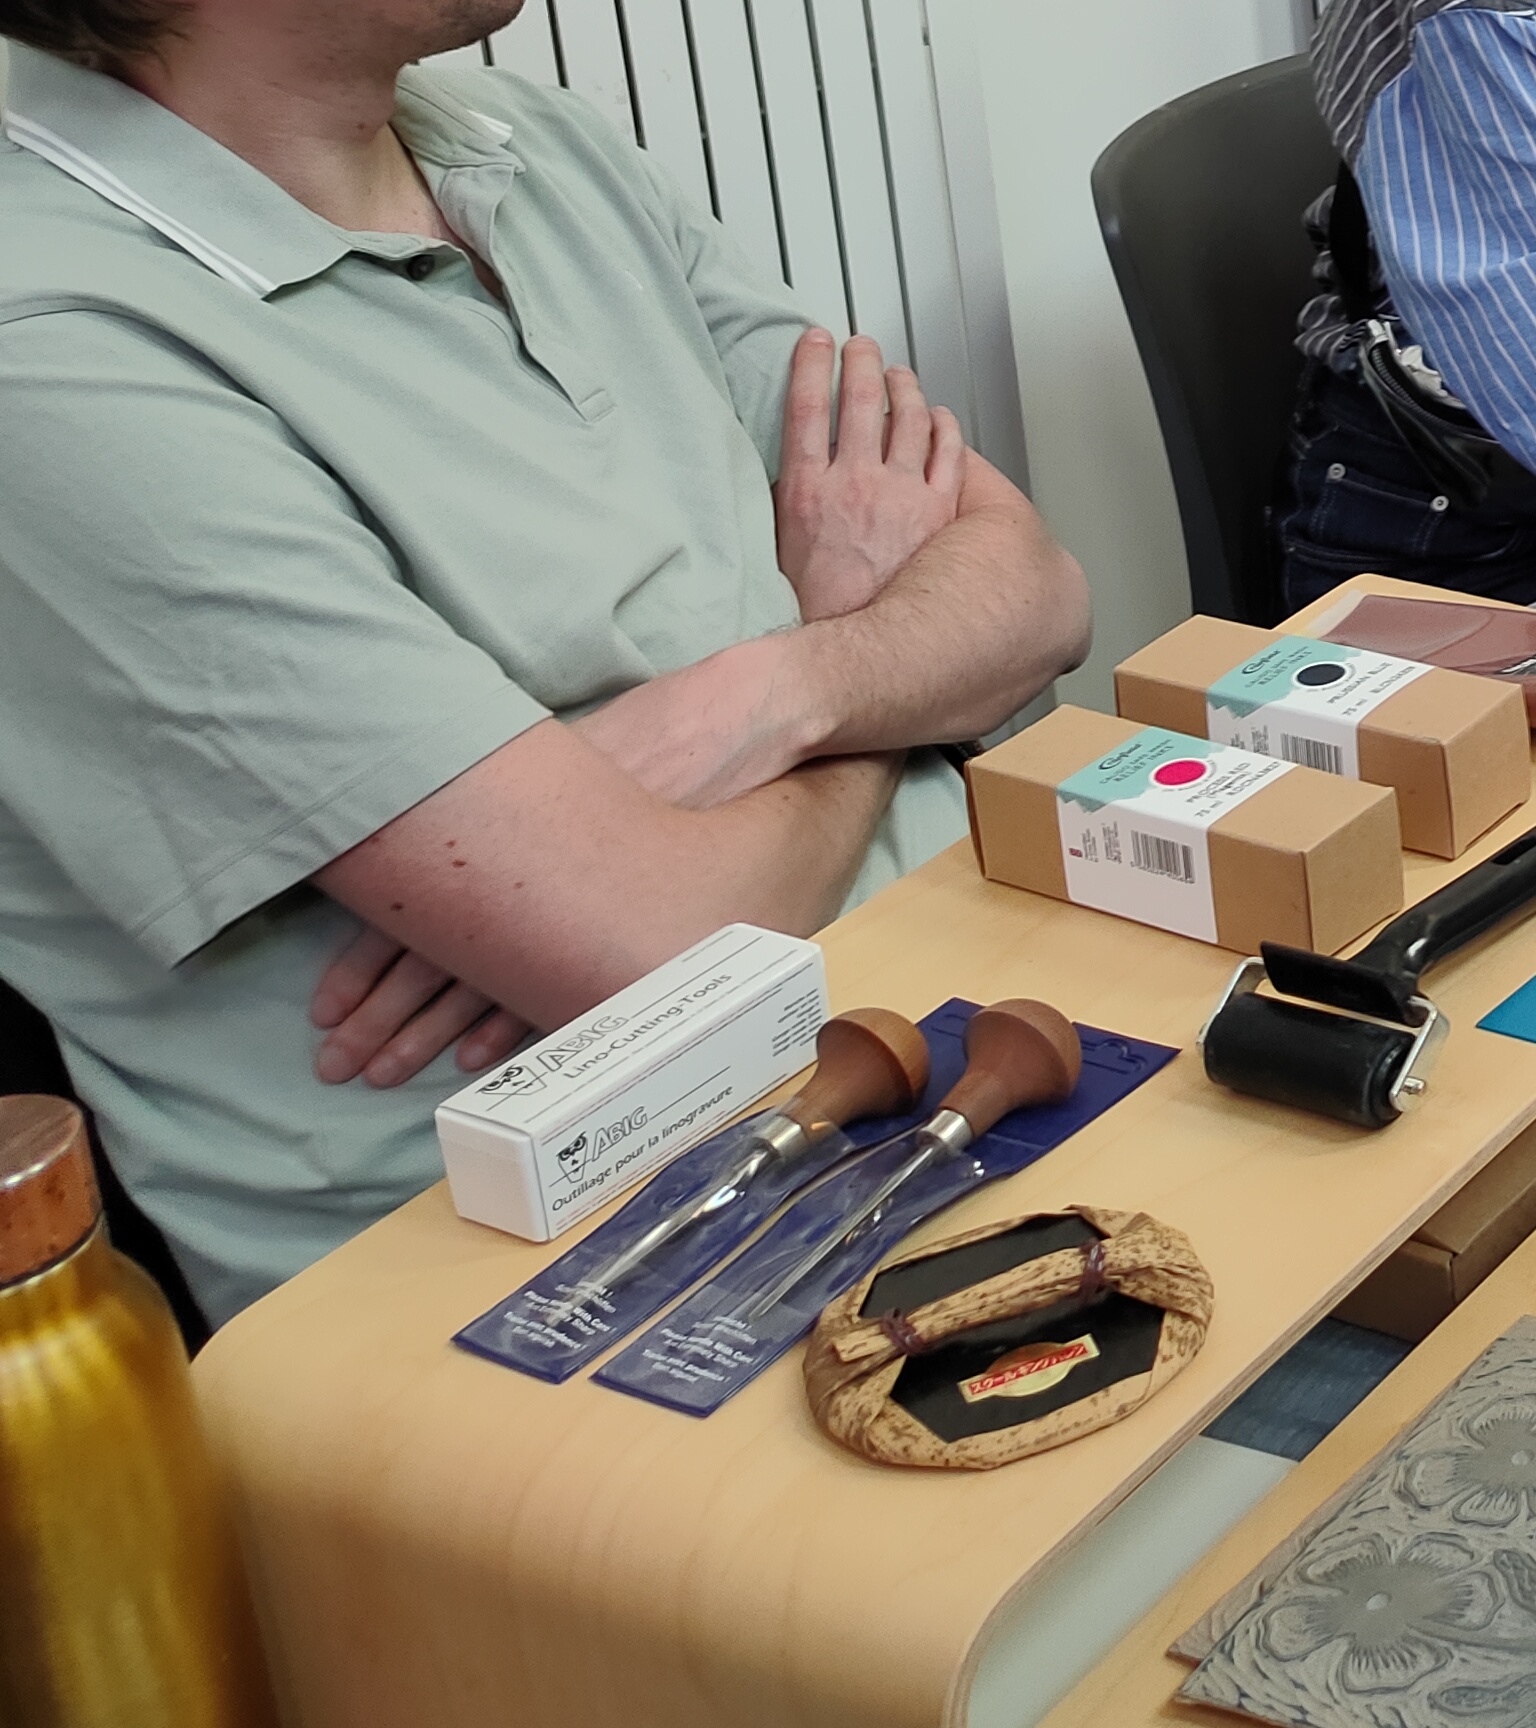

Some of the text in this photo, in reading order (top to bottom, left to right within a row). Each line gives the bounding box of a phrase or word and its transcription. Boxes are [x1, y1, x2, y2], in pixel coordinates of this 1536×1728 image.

[537, 1015, 631, 1071] ABIG
[563, 973, 732, 1079] Lino-Cutting-Tools
[552, 1086, 733, 1211] Outillage pour la linogravure
[590, 1106, 649, 1162] ABIG
